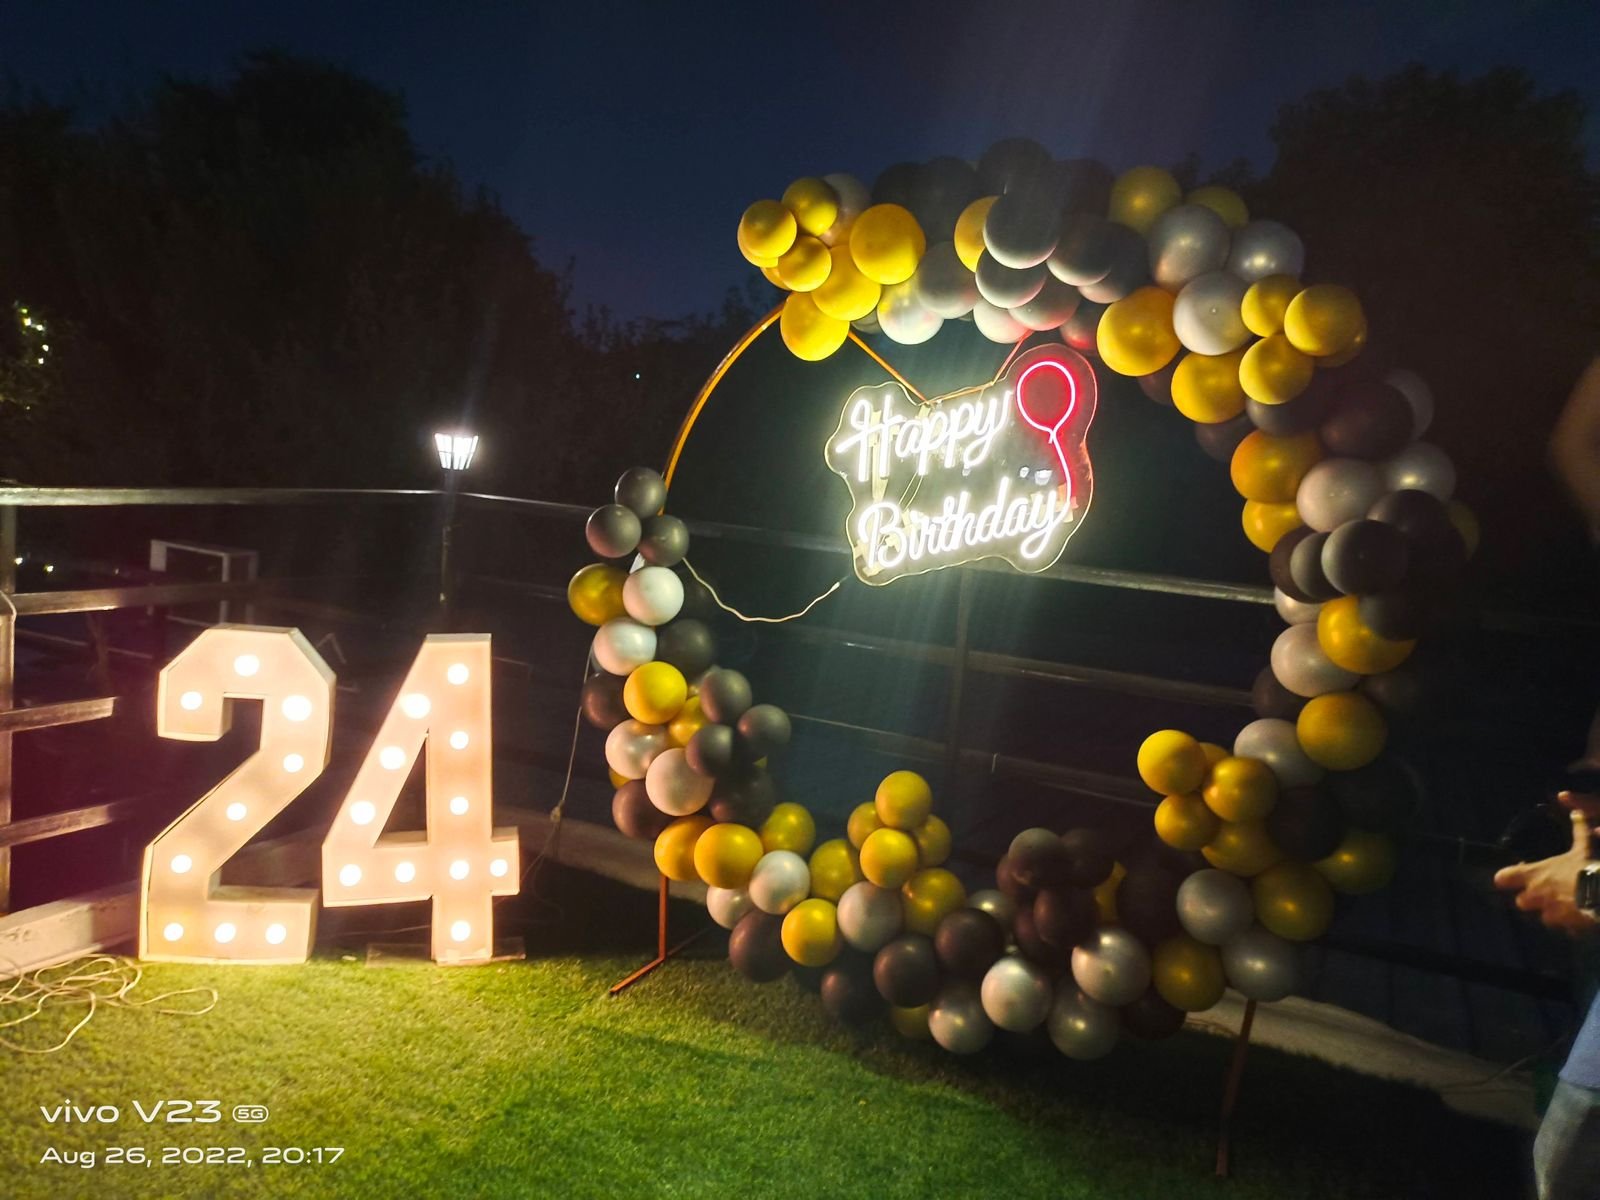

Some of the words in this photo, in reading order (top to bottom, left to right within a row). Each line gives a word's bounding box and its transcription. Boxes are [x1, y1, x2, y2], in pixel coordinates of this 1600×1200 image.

[834, 389, 1014, 482] Happy
[857, 477, 1062, 568] Birthday
[139, 623, 520, 966] 24
